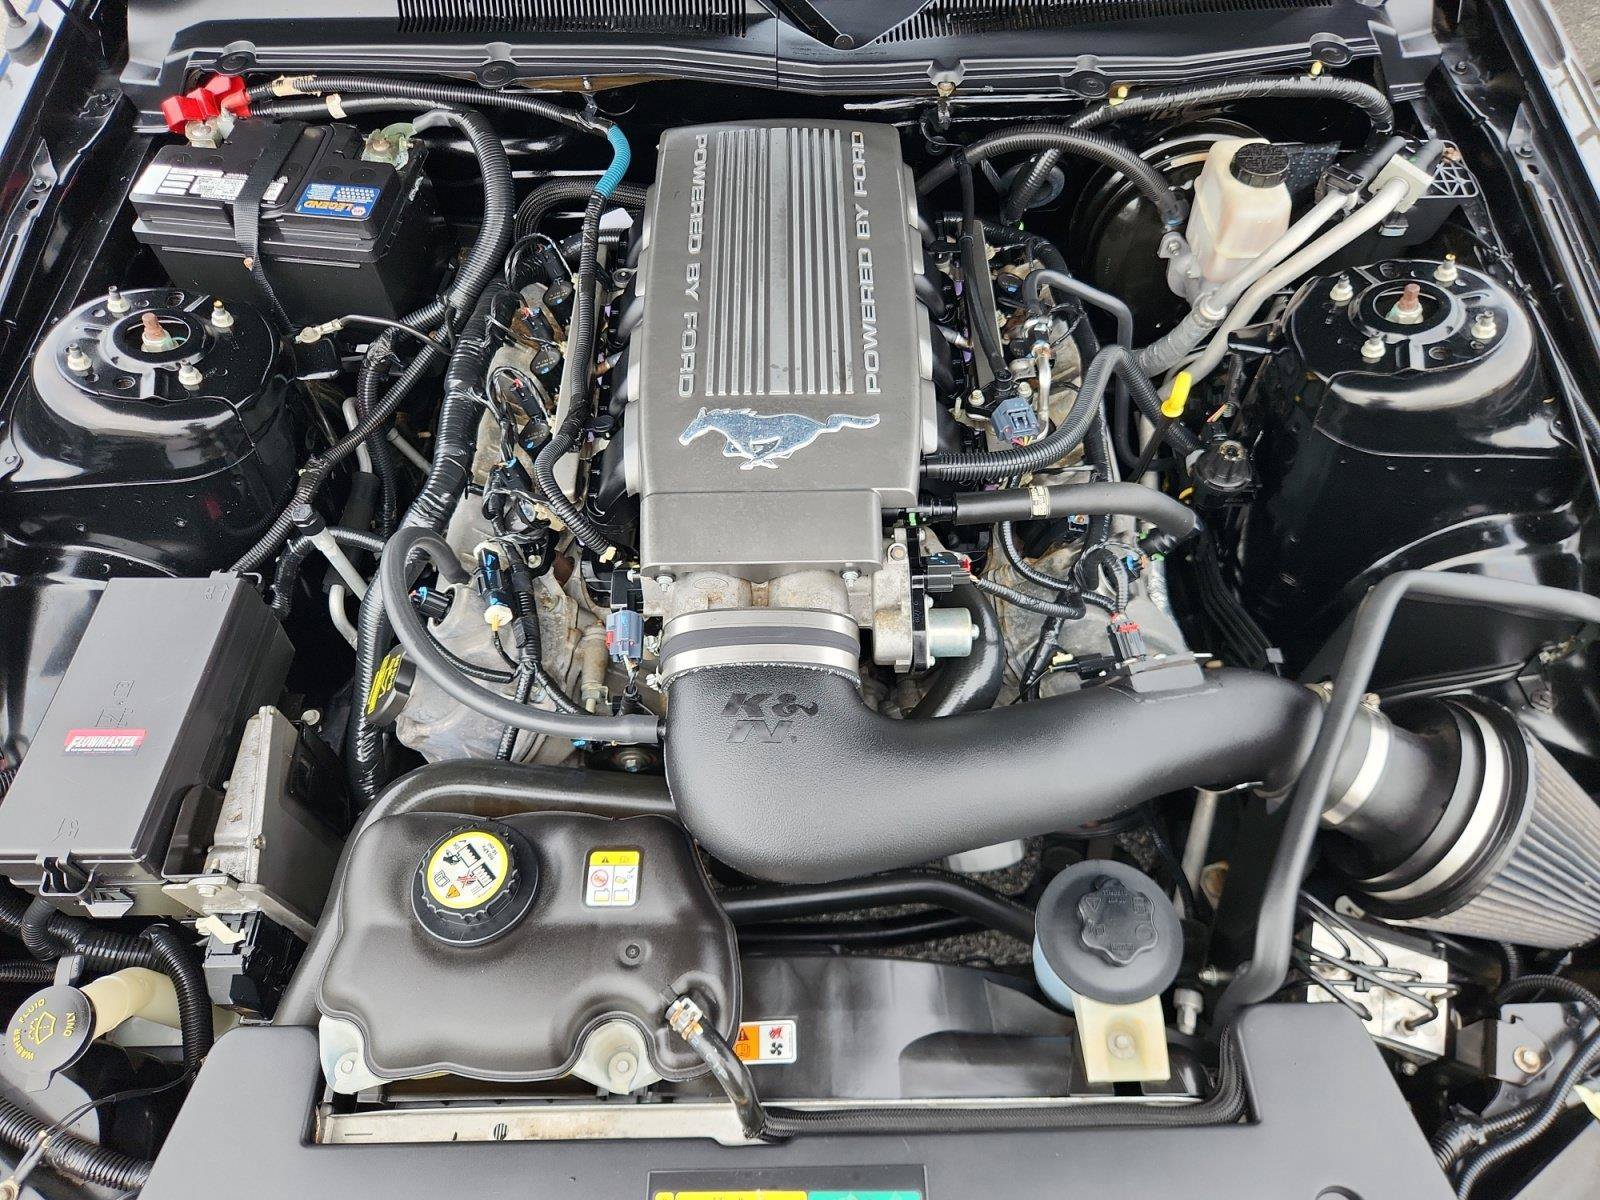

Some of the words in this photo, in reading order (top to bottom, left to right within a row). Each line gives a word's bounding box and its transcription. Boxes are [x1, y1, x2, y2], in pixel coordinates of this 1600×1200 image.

[851, 131, 868, 197] FORD
[304, 200, 353, 211] LEGEND
[687, 134, 707, 254] POWERED
[855, 203, 871, 241] BY
[684, 263, 701, 301] BY
[858, 248, 881, 394] POWERED
[677, 312, 698, 398] FORD
[65, 735, 137, 752] FLOWMASTER
[18, 998, 45, 1024] FLUID
[63, 1012, 76, 1037] ONLY
[12, 1028, 35, 1061] WASHER
